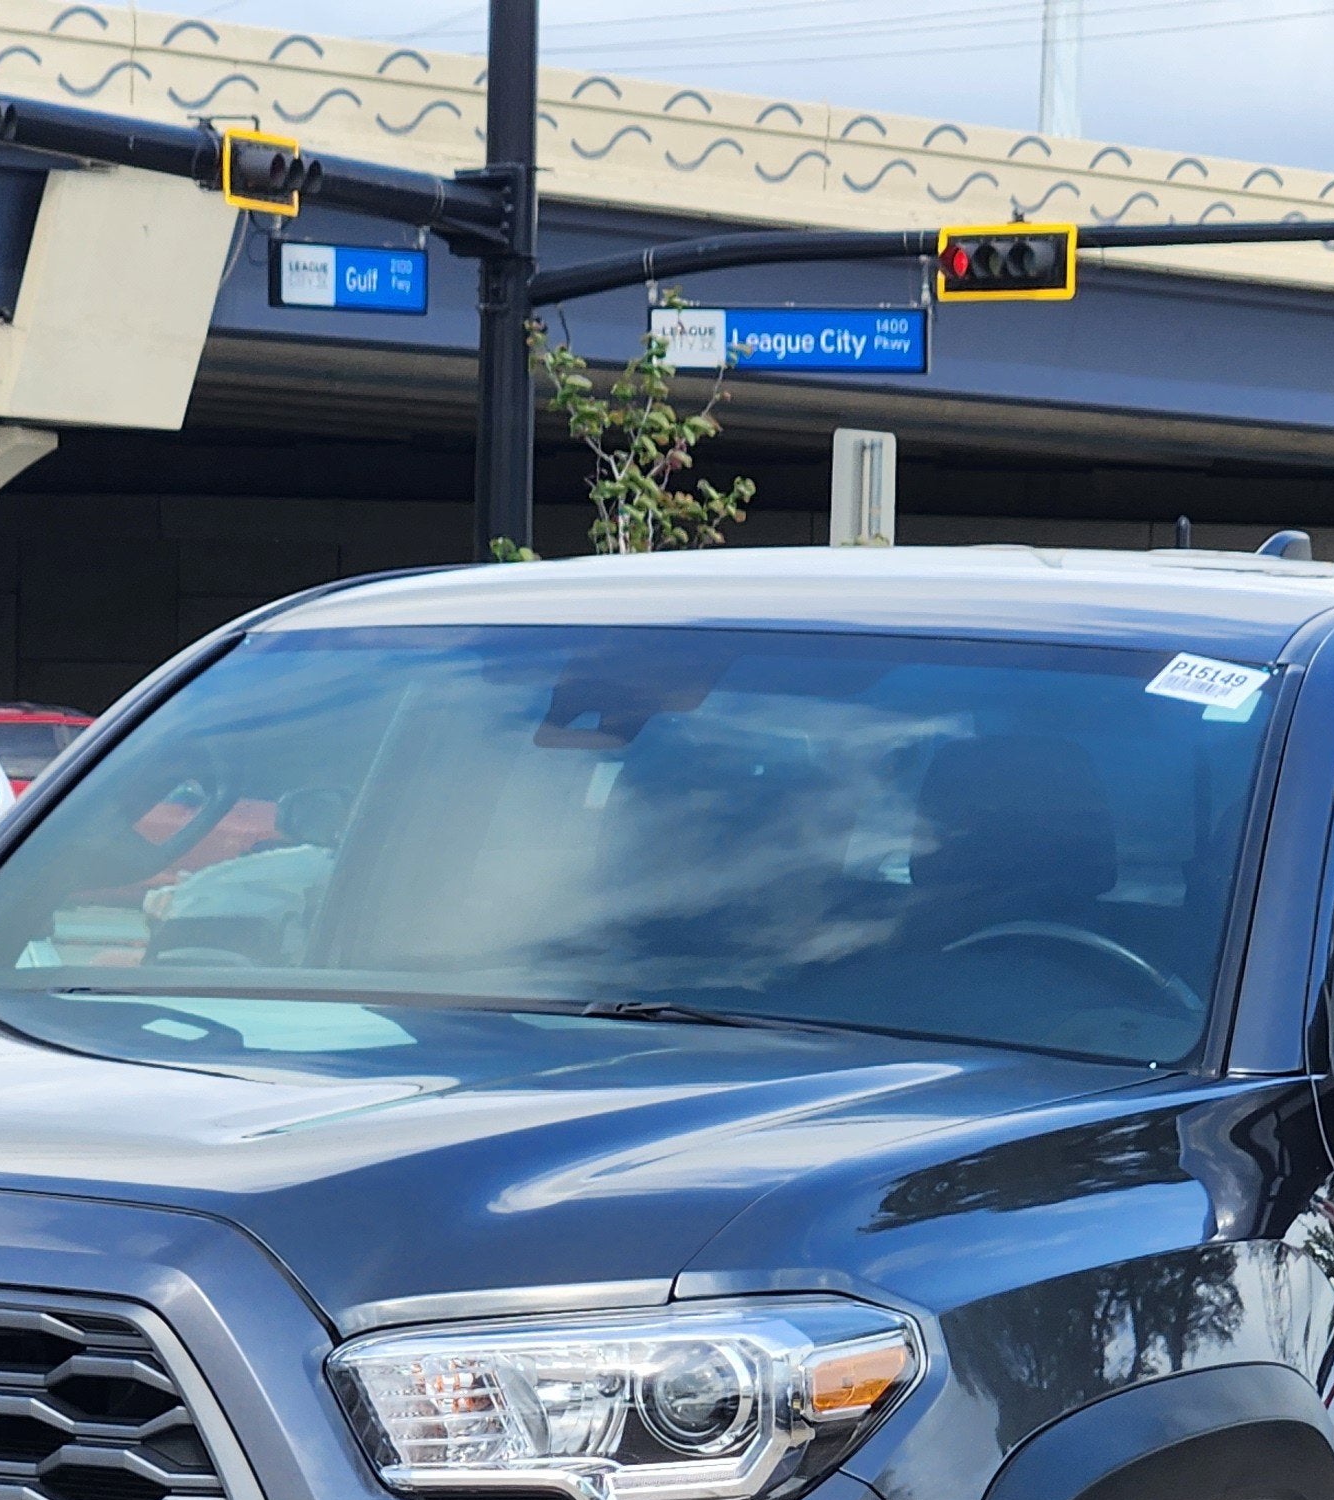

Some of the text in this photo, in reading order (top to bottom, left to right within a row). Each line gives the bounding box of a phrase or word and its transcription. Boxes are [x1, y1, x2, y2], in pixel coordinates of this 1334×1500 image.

[346, 266, 378, 293] Gulf
[876, 318, 908, 334] 1400
[732, 328, 866, 360] League City
[874, 336, 910, 354] Pkwy
[1170, 661, 1248, 688] P15149
